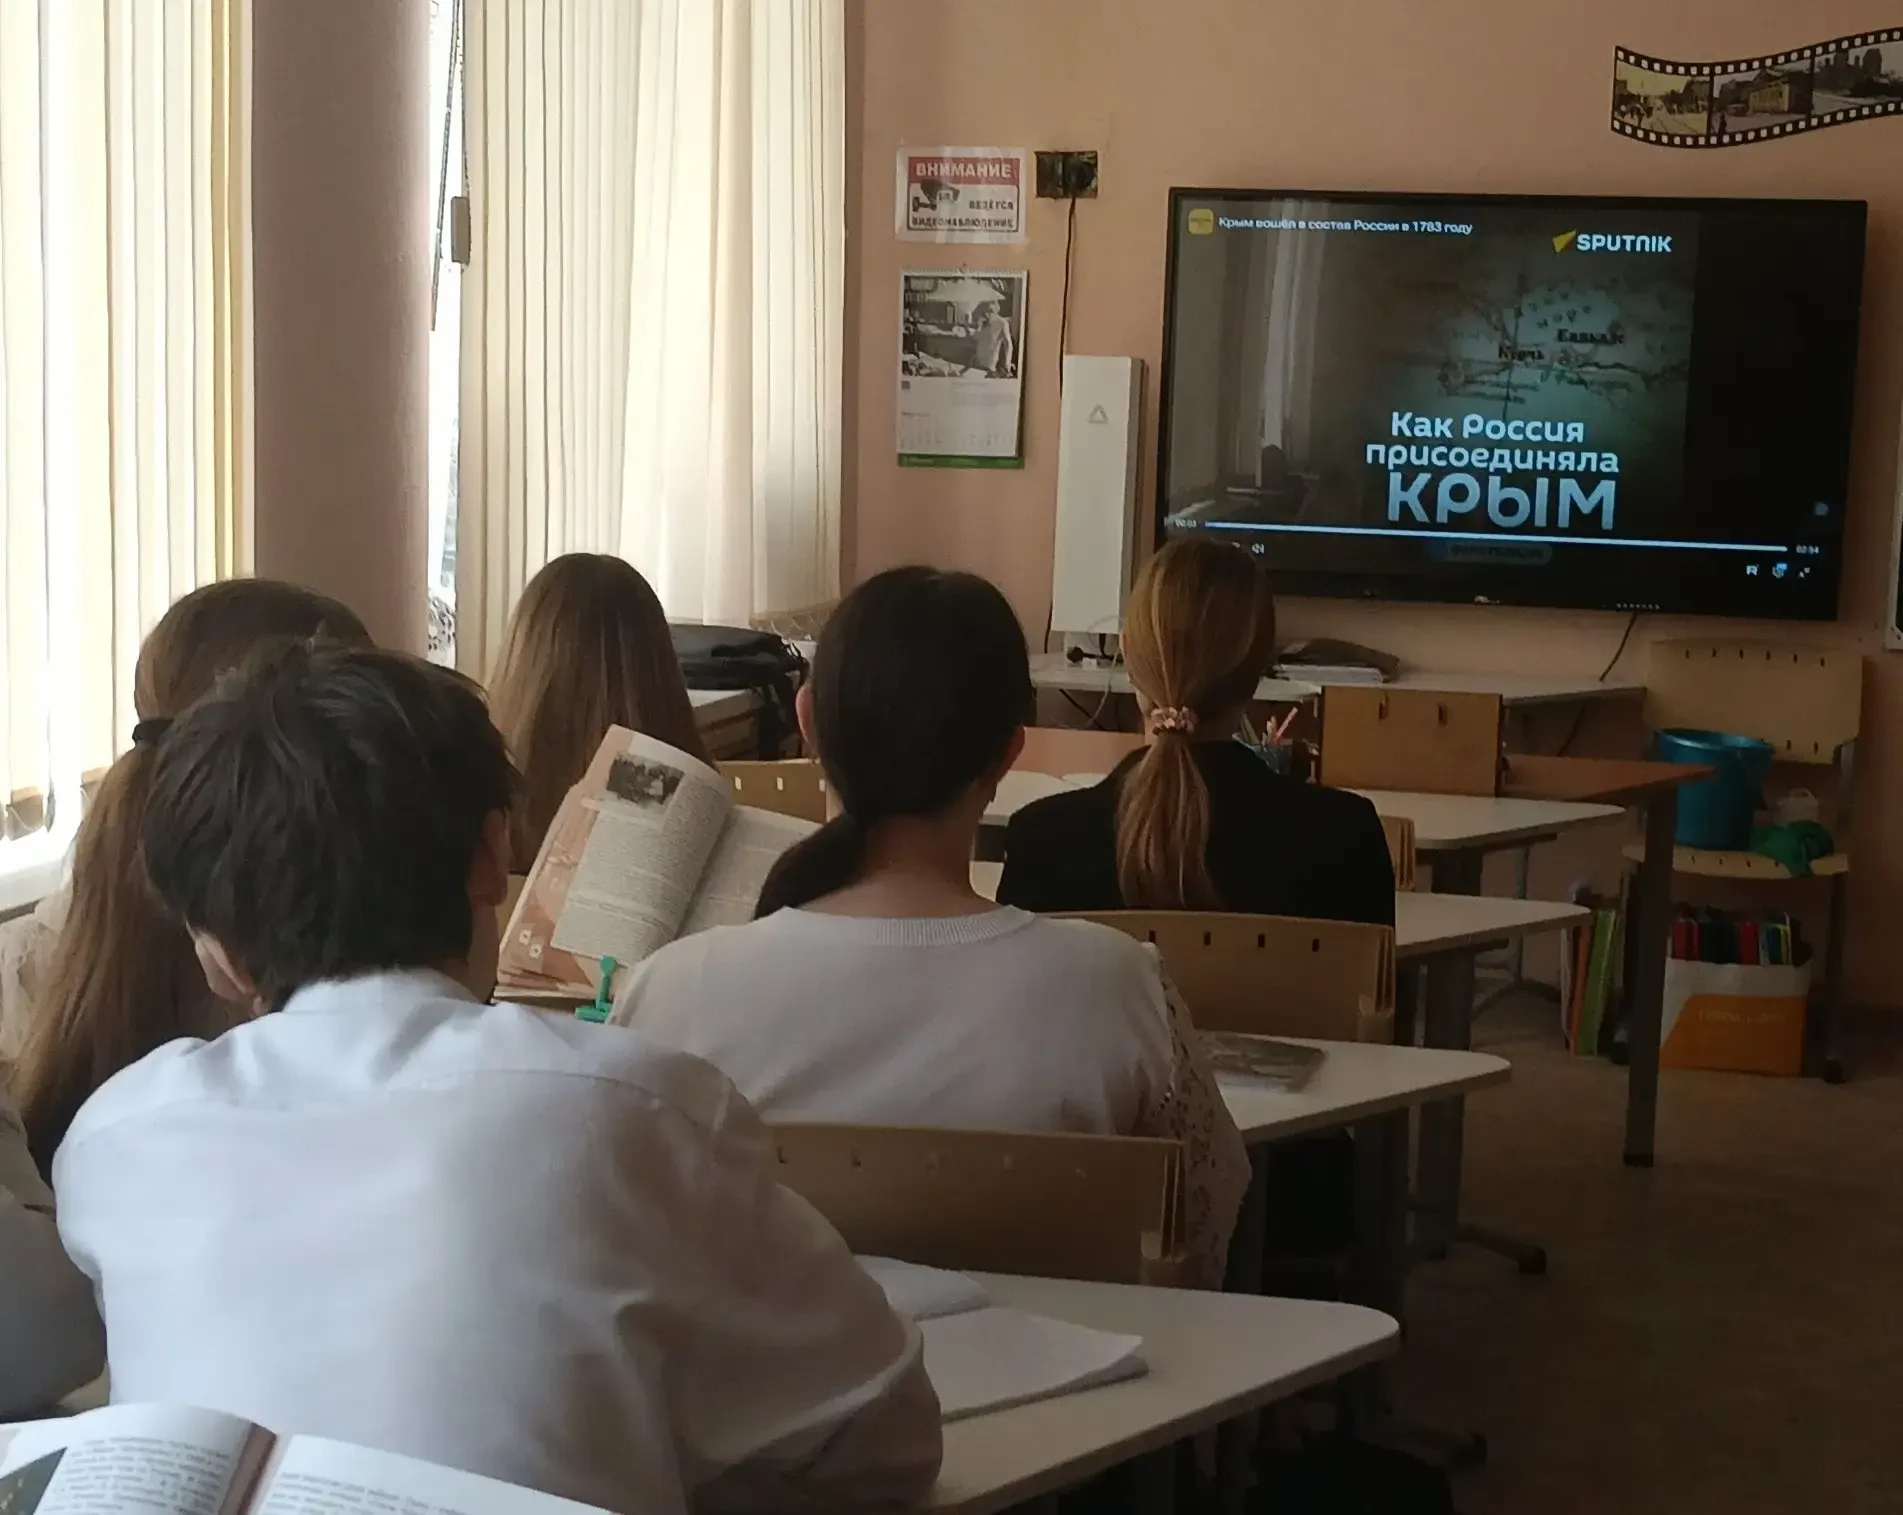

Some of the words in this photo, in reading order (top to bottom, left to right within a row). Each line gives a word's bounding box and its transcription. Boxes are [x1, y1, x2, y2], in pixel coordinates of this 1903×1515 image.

[916, 161, 1013, 178] ВНИМАНИЕ
[911, 216, 1015, 229] ВИДЕОНАБЛЮДЕНИЕ
[1218, 217, 1254, 229] Крым
[1255, 219, 1296, 229] вошёл
[1308, 221, 1351, 230] состав
[1353, 220, 1400, 231] России
[1412, 221, 1442, 232] 1783
[1444, 223, 1473, 235] году
[1577, 233, 1673, 252] SPUTNIK
[1391, 411, 1453, 438] Как
[1462, 413, 1585, 443] Россия
[1366, 443, 1620, 473] присоединяла
[1387, 471, 1617, 531] КРЫМ
